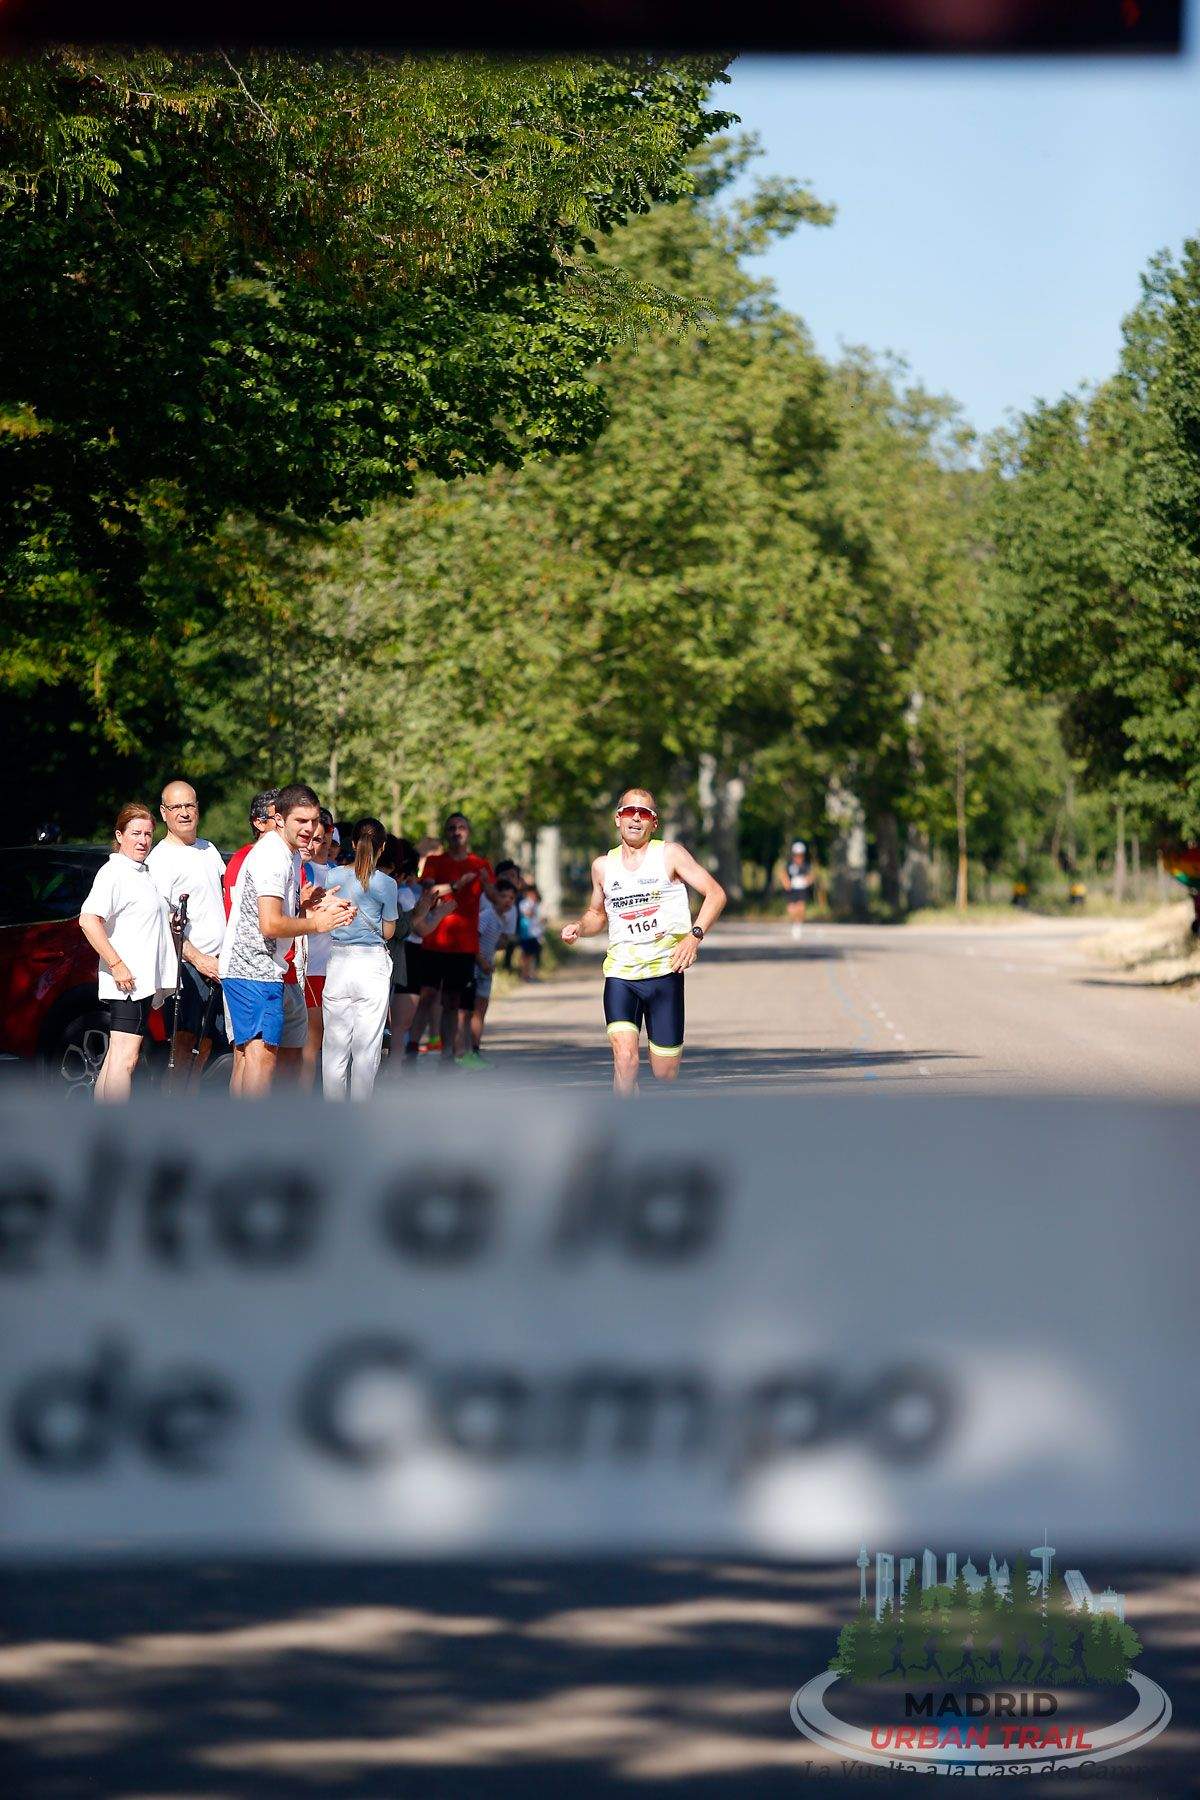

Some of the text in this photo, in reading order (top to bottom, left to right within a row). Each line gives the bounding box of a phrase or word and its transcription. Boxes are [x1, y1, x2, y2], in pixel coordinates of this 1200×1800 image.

[627, 918, 658, 935] 1164
[377, 1158, 501, 1274] a
[546, 1128, 734, 1274] la
[8, 1330, 957, 1488] de Campo
